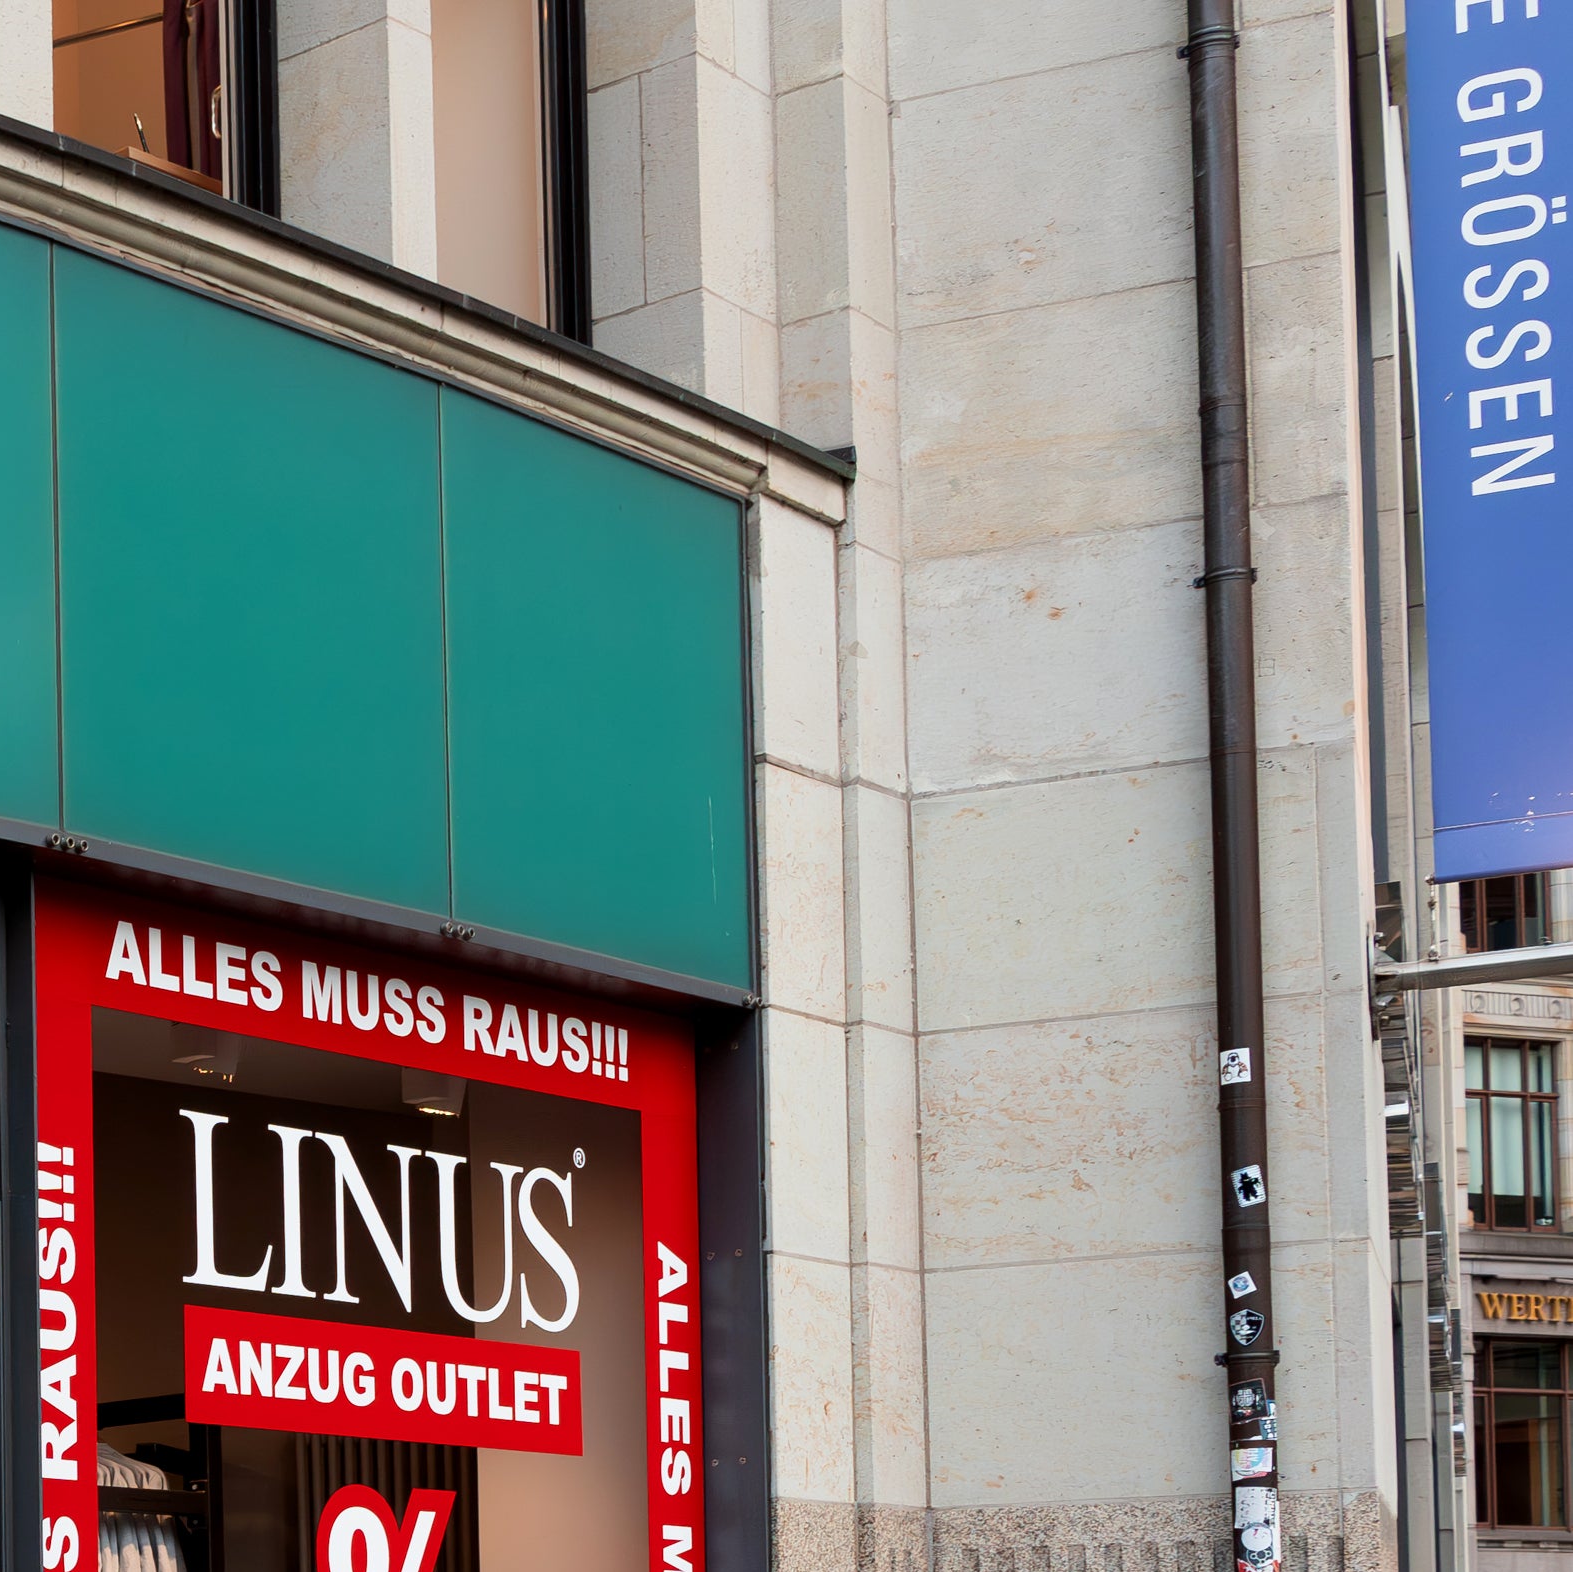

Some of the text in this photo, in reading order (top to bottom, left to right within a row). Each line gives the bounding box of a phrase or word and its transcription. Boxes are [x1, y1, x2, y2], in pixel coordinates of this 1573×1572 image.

[1457, 68, 1567, 497] GRÖSSEN
[106, 922, 629, 1083] ALLES MUSS RAUS!!!
[37, 1141, 79, 1481] RAUS!!!
[203, 1338, 568, 1426] ANZUG OUTLET
[658, 1242, 692, 1496] ALLES
